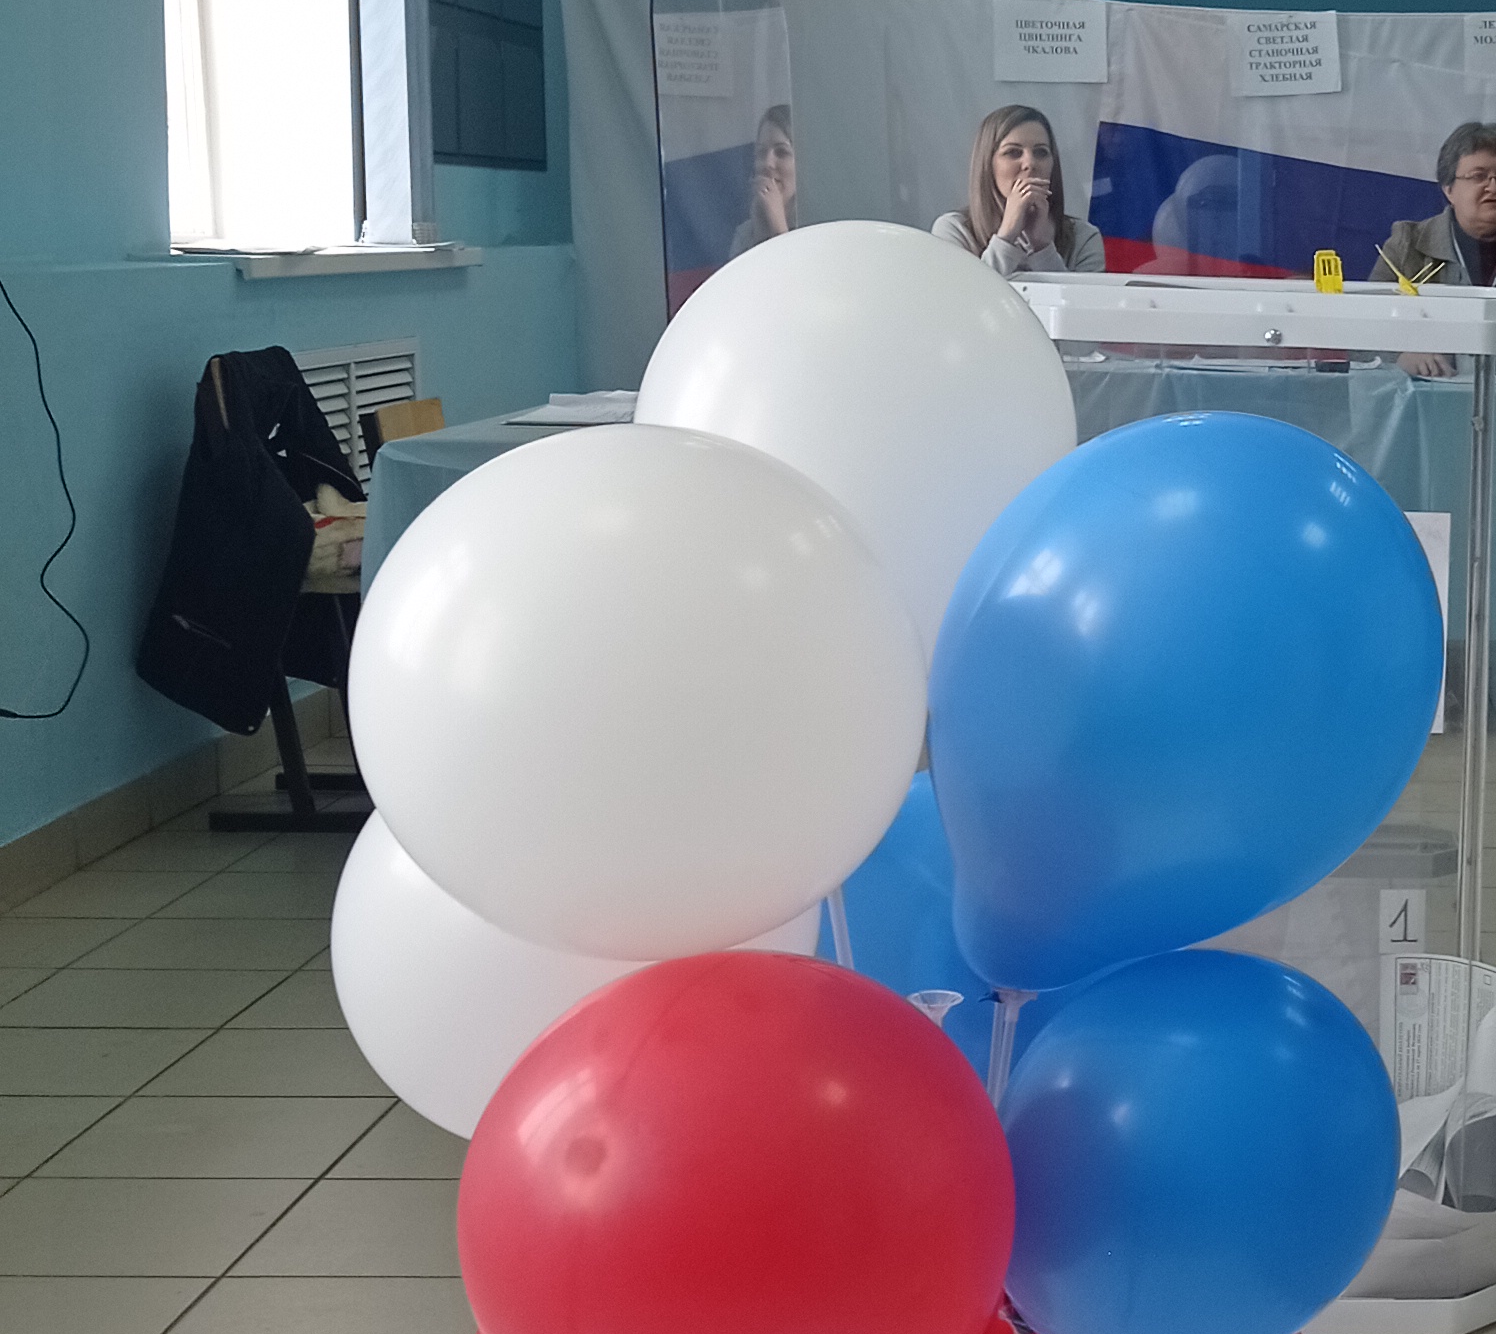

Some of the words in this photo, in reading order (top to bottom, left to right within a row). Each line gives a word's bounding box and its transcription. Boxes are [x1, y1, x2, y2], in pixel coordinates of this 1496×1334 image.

[1015, 19, 1086, 30] ЦВЕТОЧНАЯ
[1247, 21, 1317, 33] САМАРСКАЯ
[1257, 34, 1309, 46] СВЕТЛАЯ
[1023, 45, 1079, 55] ЧКАЛОВА
[1248, 46, 1319, 58] СТАНОЧНАЯ
[1248, 58, 1322, 70] ТРАКТОРНАЯ
[1259, 71, 1313, 83] ХЛЕБНАЯ
[1389, 898, 1418, 943] 1
